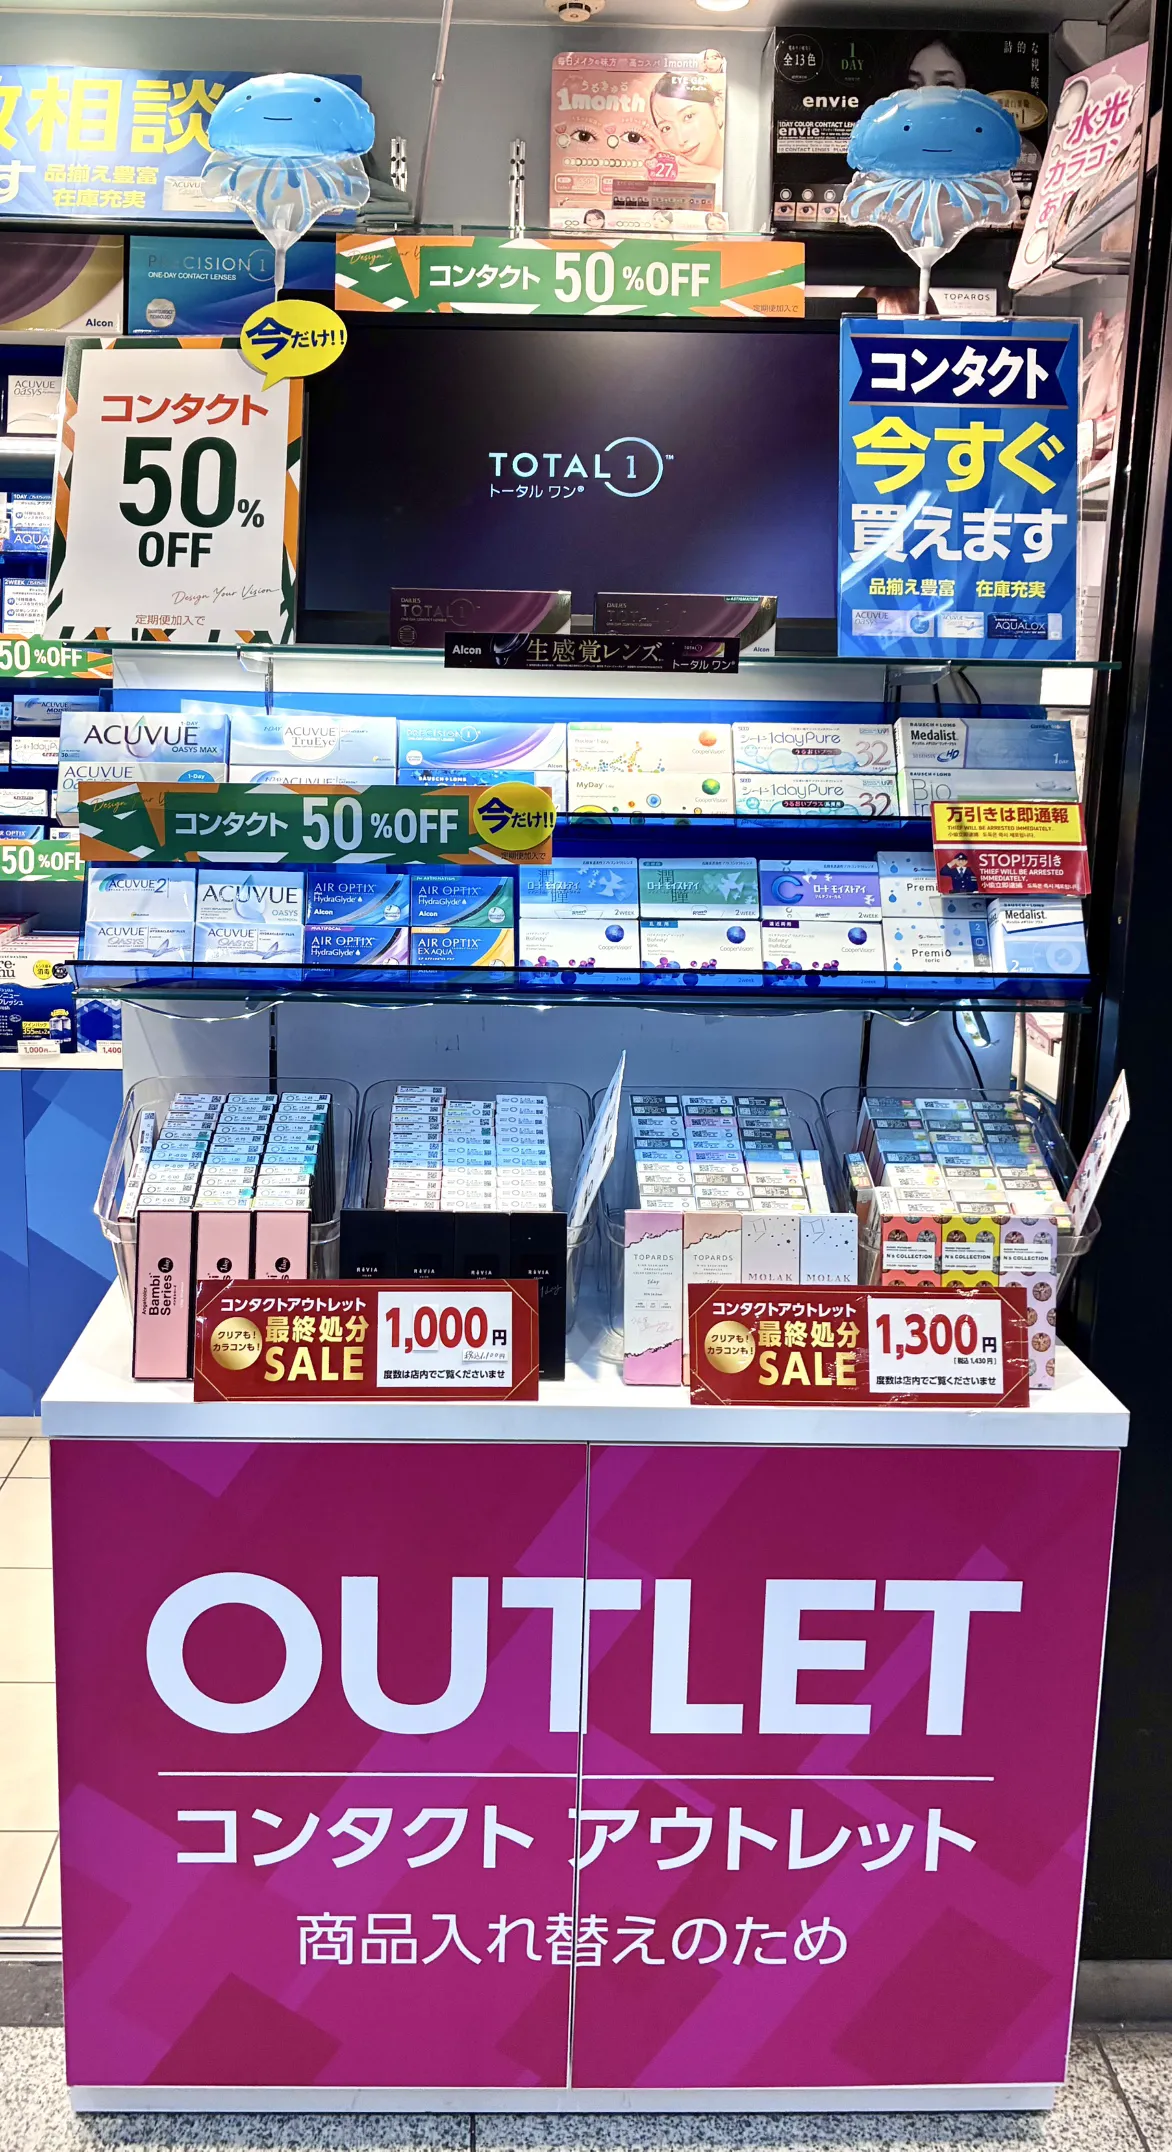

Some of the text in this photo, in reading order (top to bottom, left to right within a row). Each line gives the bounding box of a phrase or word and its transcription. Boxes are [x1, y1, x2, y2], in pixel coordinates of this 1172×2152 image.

[664, 57, 699, 68] 1month
[783, 52, 817, 67] 全13色
[841, 59, 864, 71] DAY
[556, 87, 646, 113] 1month
[802, 96, 859, 108] envie
[1066, 90, 1130, 145] 水光
[779, 127, 820, 136] envie
[45, 164, 159, 185] 品揃え豊富
[52, 190, 146, 208] 在庫充実
[178, 272, 208, 280] CONTACT
[430, 251, 711, 303] コンタクト 50 %OFF
[86, 319, 113, 327] Alcon
[245, 316, 345, 360] 今だけ!!
[871, 345, 1049, 400] コンタクト
[14, 380, 55, 389] ACUVUE
[101, 393, 269, 426] コンタクト
[851, 416, 1065, 495] 今すぐ
[489, 452, 637, 478] TOTAL 1
[850, 503, 1067, 563] 買えます
[138, 531, 213, 568] OFF
[171, 584, 280, 605] Design Your Vision
[869, 578, 1046, 599] 品揃え豊富 在庫充実
[135, 614, 206, 626] 定期便加入で
[855, 611, 889, 620] ACUVUE
[995, 621, 1046, 631] AQUALOX
[452, 644, 482, 656] Alcon
[526, 637, 663, 664] 生感覚レンズ
[84, 724, 199, 747] ACUVUE
[285, 726, 337, 737] ACUVUE
[911, 730, 956, 741] Medalist
[291, 736, 336, 746] TruEye
[741, 732, 841, 747] シード 1dayPure
[855, 740, 891, 767] 32
[65, 766, 133, 778] ACUVUE
[742, 784, 844, 799] シード 1dayPure
[911, 778, 951, 801] Bio
[858, 792, 894, 817] 32
[477, 796, 554, 835] 今だけ!!
[946, 806, 1069, 824] 万引きは即通報
[175, 796, 459, 851] コンタクト 50 %OFF
[2, 846, 34, 875] 50
[109, 879, 154, 889] ACUVUE
[155, 877, 166, 893] 2
[314, 883, 376, 893] AIR OPTIX
[418, 887, 480, 896] AIR OPTIX
[527, 881, 580, 890] ロート モイストアイ
[647, 881, 700, 890] ロート モイストアイ
[813, 884, 867, 894] ロート モイストアイ
[203, 884, 298, 904] ACUVUE
[314, 896, 357, 904] HydraGlyde
[418, 897, 461, 905] HydraGlyde
[313, 908, 334, 916] Alcon
[1005, 910, 1047, 920] Medalist
[98, 927, 146, 936] ACUVUE
[207, 928, 255, 938] ACUVUE
[311, 936, 375, 946] AIR OPTIX
[418, 939, 481, 948] AIR OPTIX
[311, 948, 355, 956] HydraGlyde
[418, 948, 453, 957] EX AQUA
[911, 949, 952, 957] Premio
[633, 1253, 674, 1261] TOPARDS
[748, 1273, 793, 1281] MOLAK
[806, 1274, 851, 1283] MOLAK
[148, 1274, 160, 1316] Bambi
[160, 1274, 172, 1316] Series
[221, 1297, 366, 1312] コンタクトアウトレット
[712, 1302, 857, 1317] コンタクトアウトレット
[265, 1315, 370, 1343] 最終処分
[758, 1321, 860, 1348] 最終処分
[264, 1346, 364, 1382] SALE
[758, 1351, 857, 1386] SALE
[383, 1369, 506, 1380] 度数は店内でご覧くださいませ
[876, 1375, 997, 1387] 度数は店内でご覧くださいませ
[146, 1571, 1023, 1735] OUTLET
[176, 1805, 976, 1872] コンタクト アウトレット
[296, 1911, 848, 1967] 商品入れ替えのため
